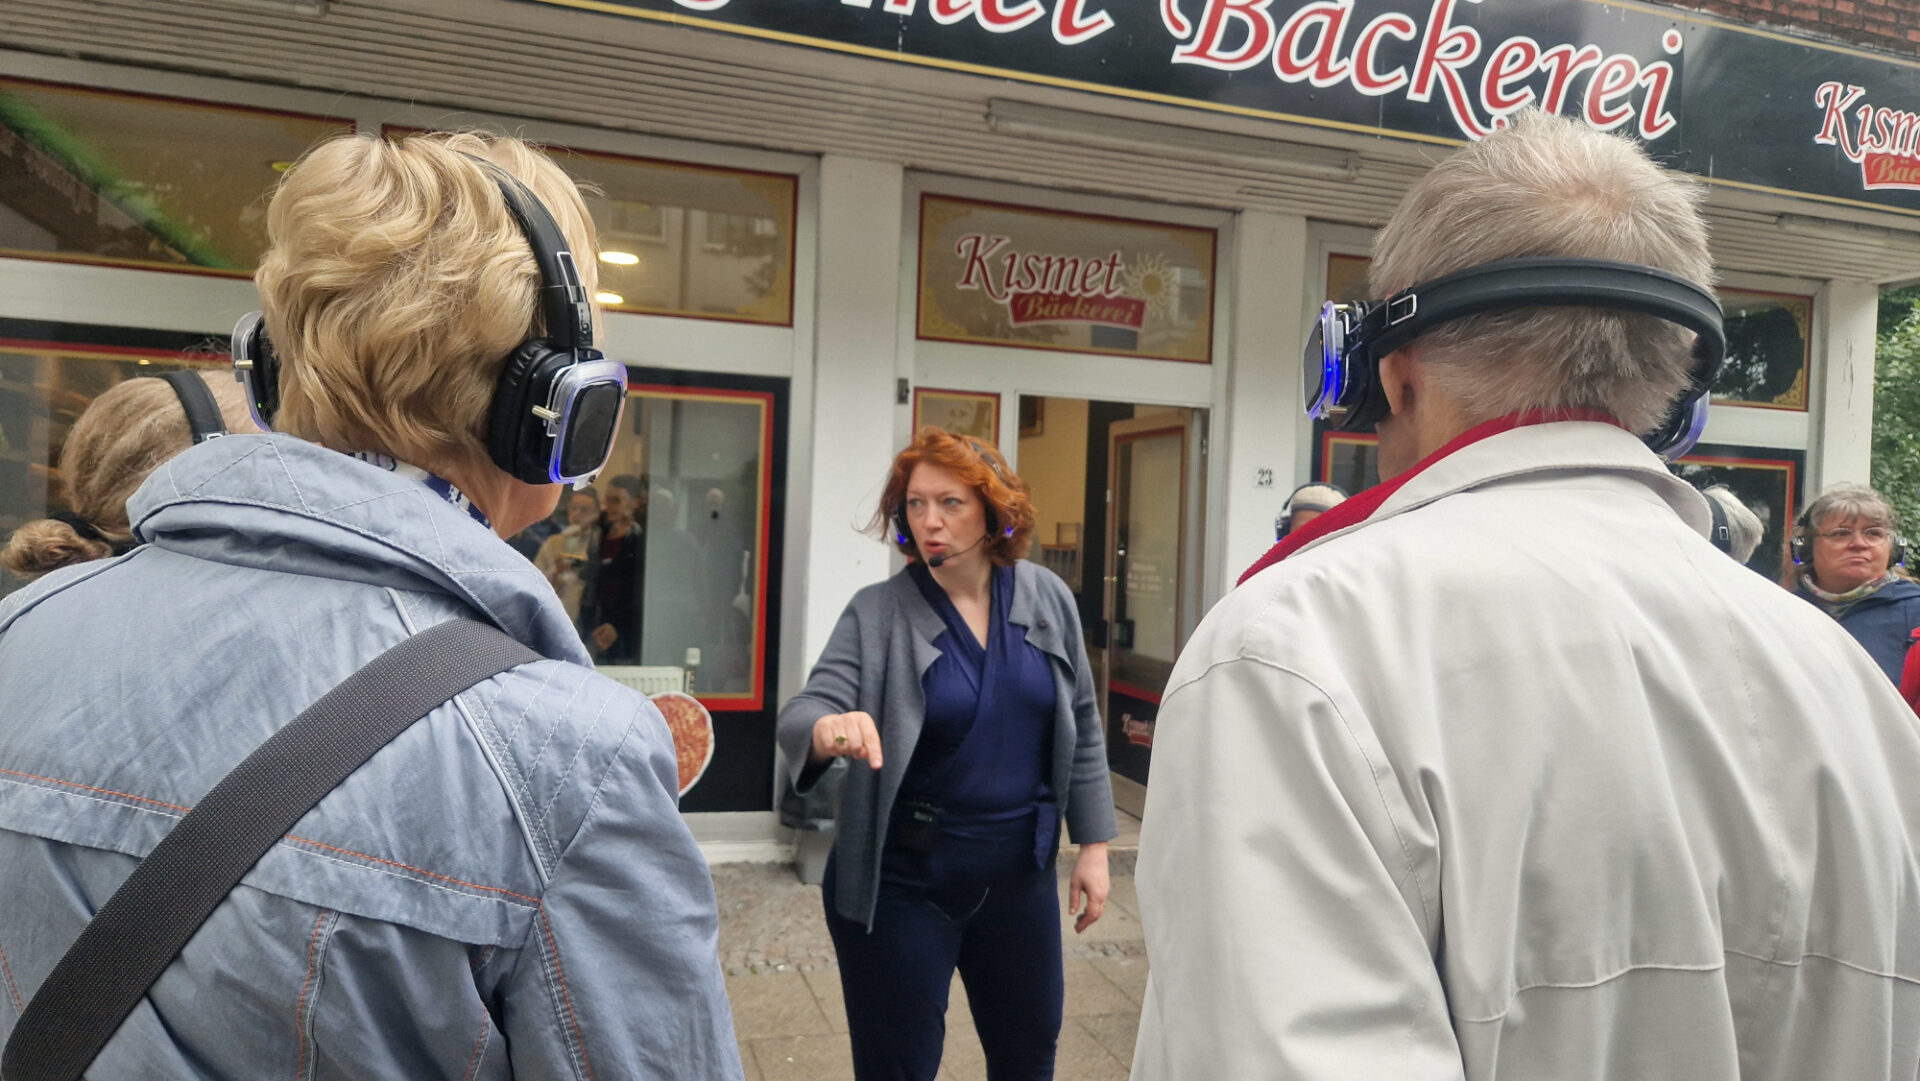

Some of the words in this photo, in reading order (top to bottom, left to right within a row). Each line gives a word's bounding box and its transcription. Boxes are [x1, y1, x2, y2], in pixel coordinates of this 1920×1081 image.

[955, 234, 1122, 303] Kismet
[1017, 296, 1137, 323] Bäckerei
[1257, 468, 1272, 486] 23
